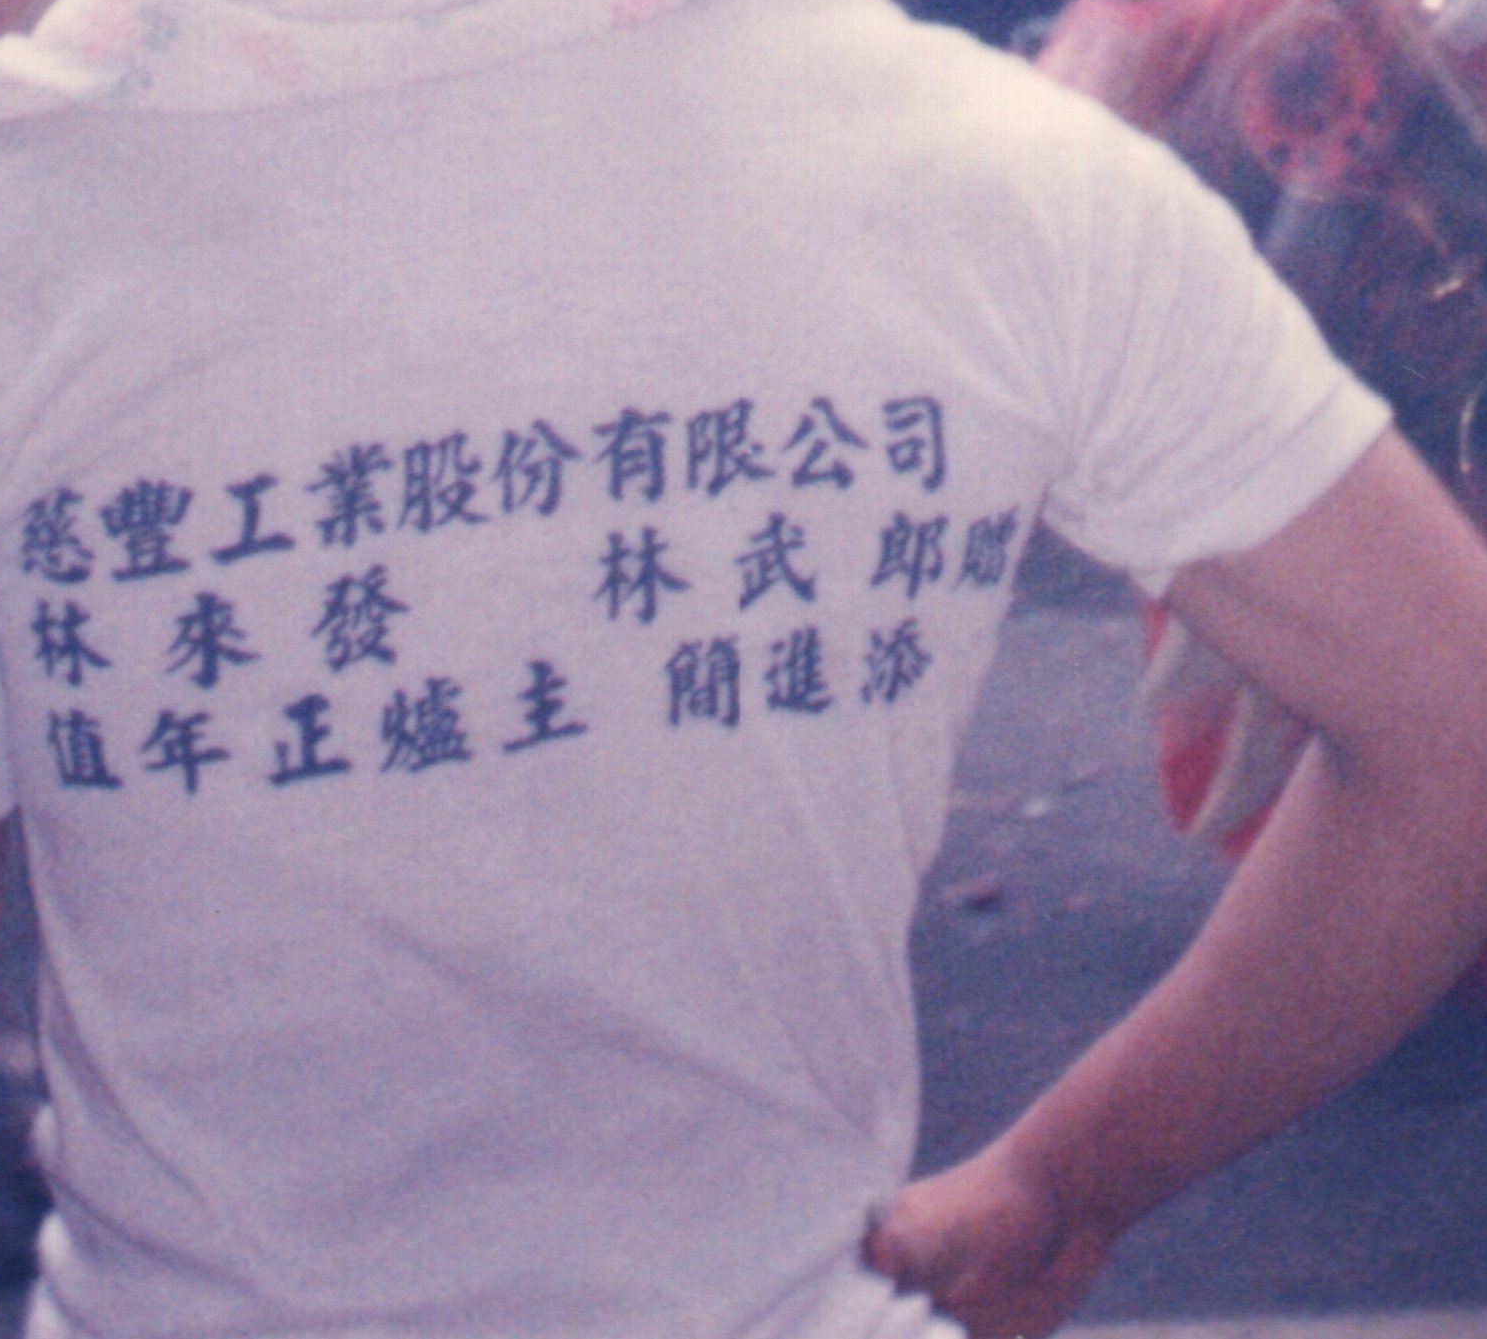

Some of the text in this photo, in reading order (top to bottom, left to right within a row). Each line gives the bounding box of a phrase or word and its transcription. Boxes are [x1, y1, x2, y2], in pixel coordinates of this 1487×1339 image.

[18, 395, 948, 584] 慈豐工業股份有限公司
[30, 564, 410, 688] 林來發
[46, 660, 588, 794] 值年正爐主
